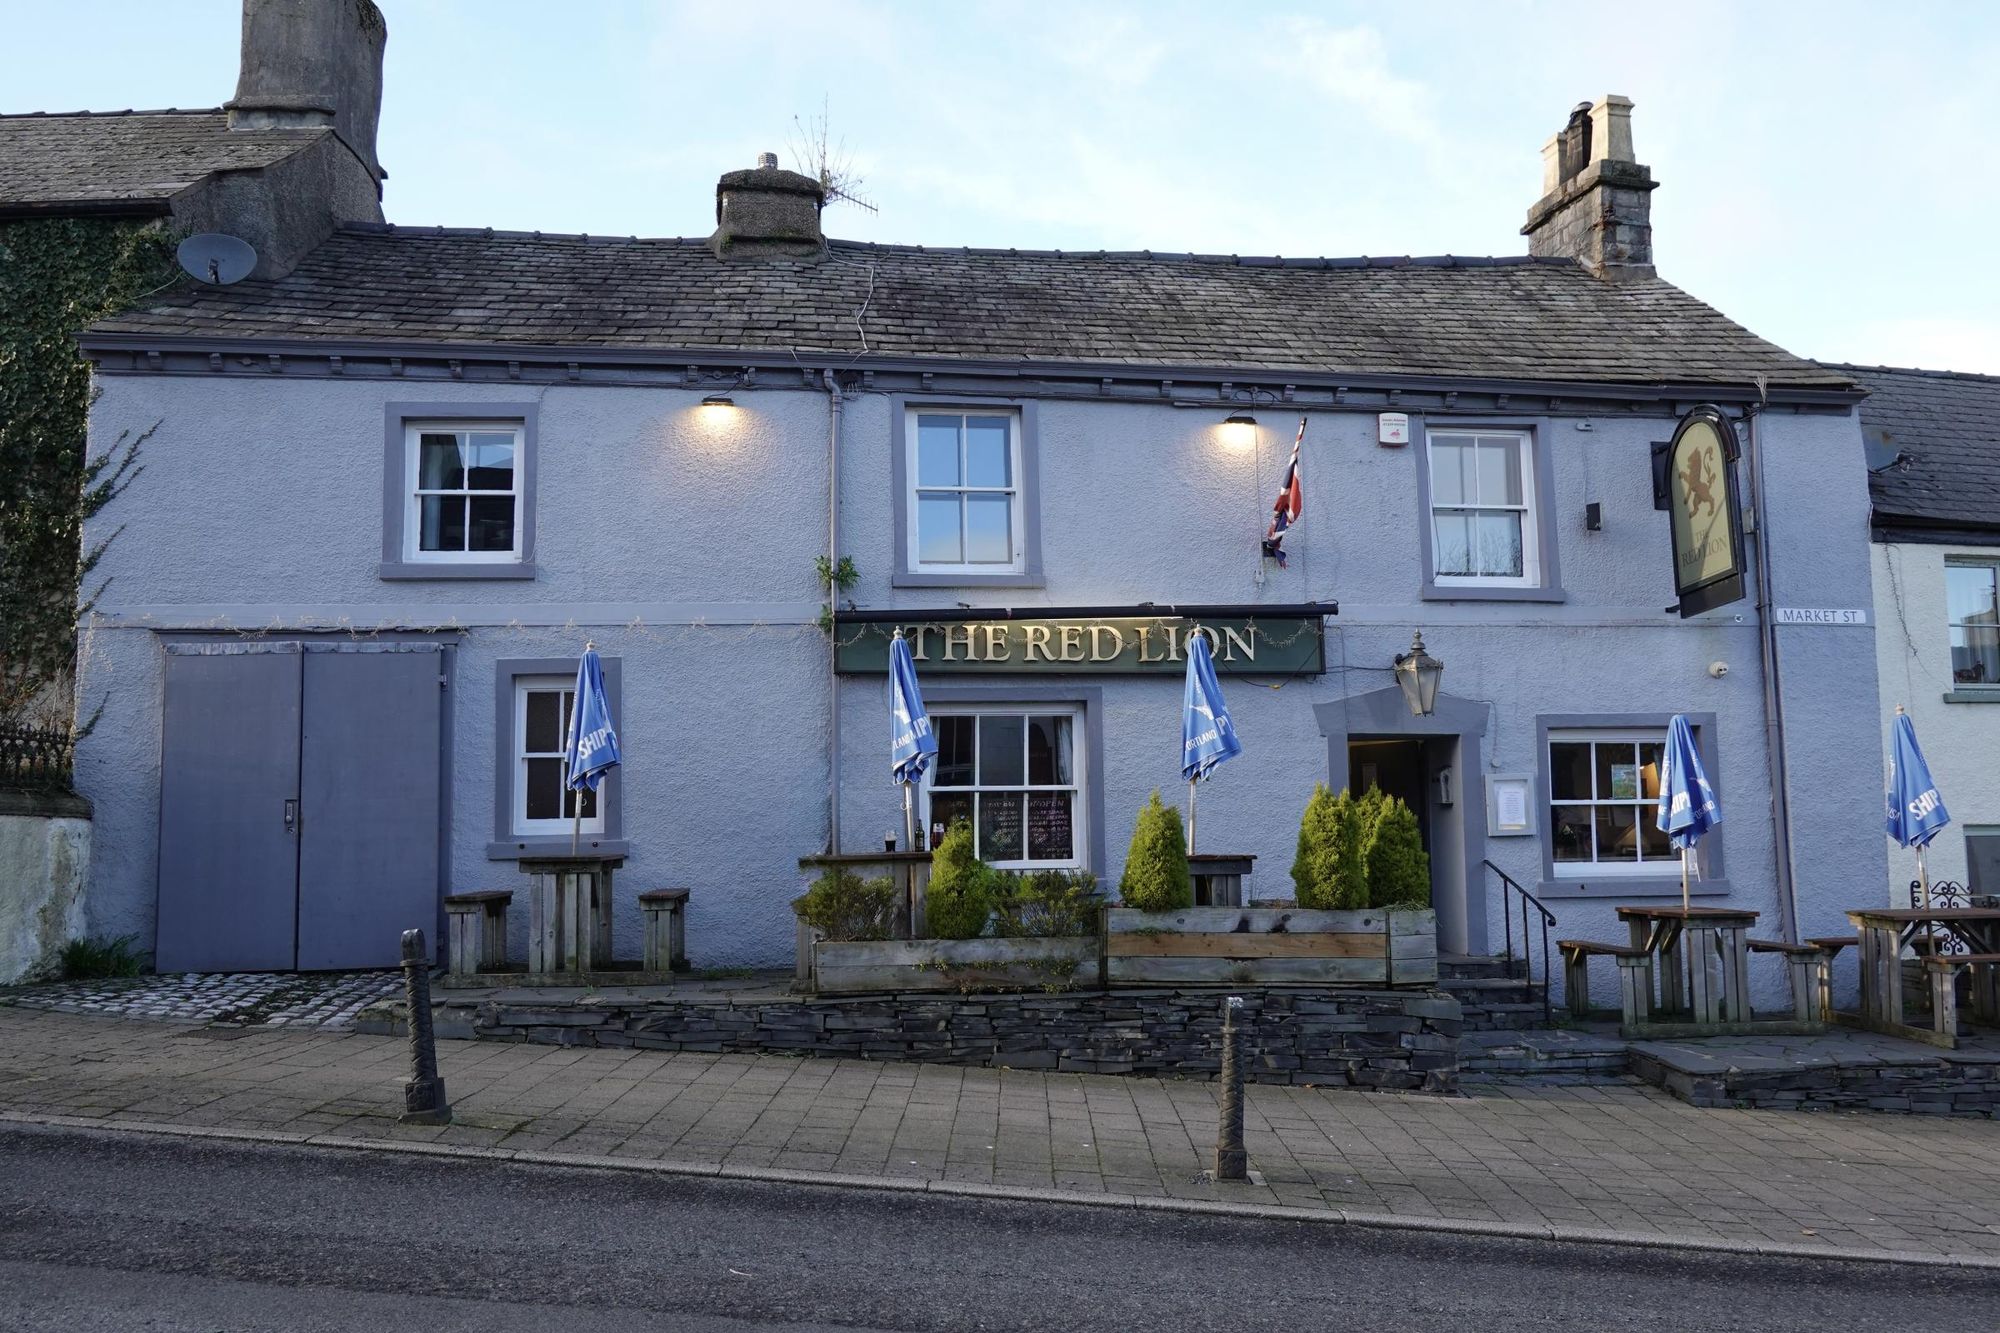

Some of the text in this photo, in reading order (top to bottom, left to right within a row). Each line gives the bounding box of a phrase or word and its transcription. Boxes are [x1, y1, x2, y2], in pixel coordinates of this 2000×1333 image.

[1783, 609, 1857, 622] MARKET ST
[904, 624, 1257, 661] THE RED LION
